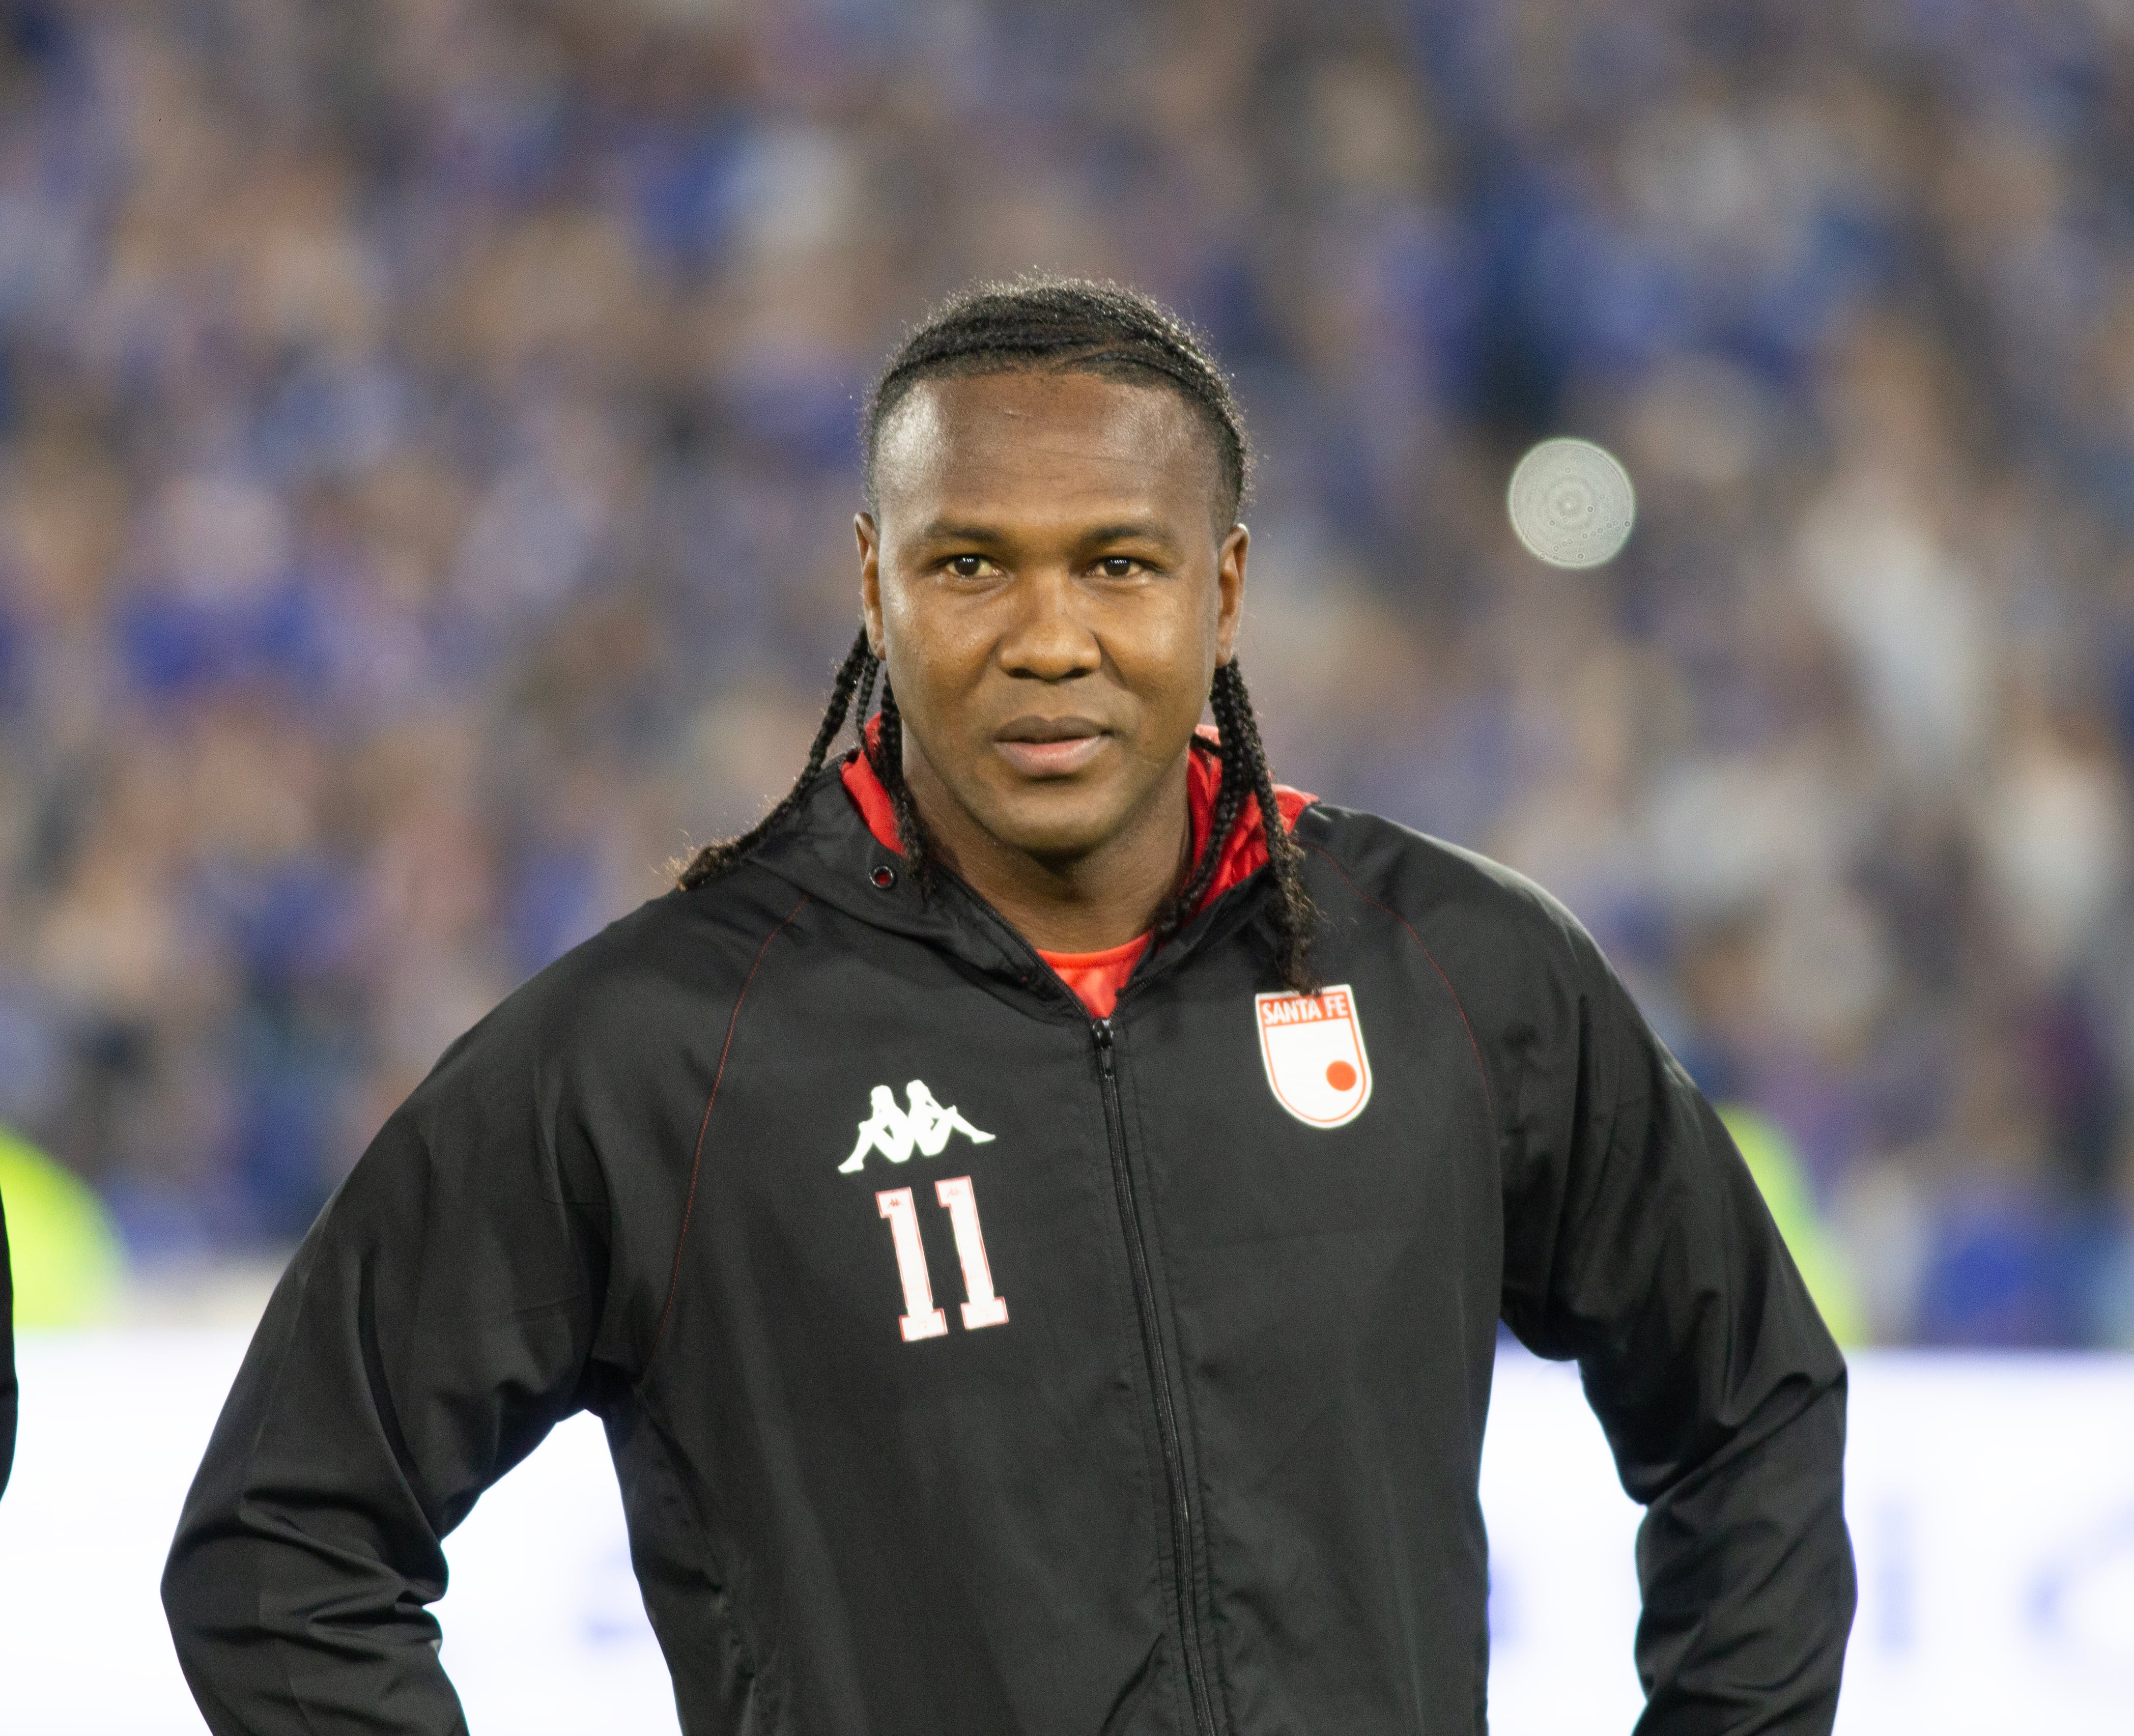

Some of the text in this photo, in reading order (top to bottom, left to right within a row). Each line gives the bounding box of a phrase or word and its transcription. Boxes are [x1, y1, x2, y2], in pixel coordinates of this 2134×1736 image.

[1262, 994, 1348, 1024] SANTA FE
[875, 1176, 1009, 1342] 11
